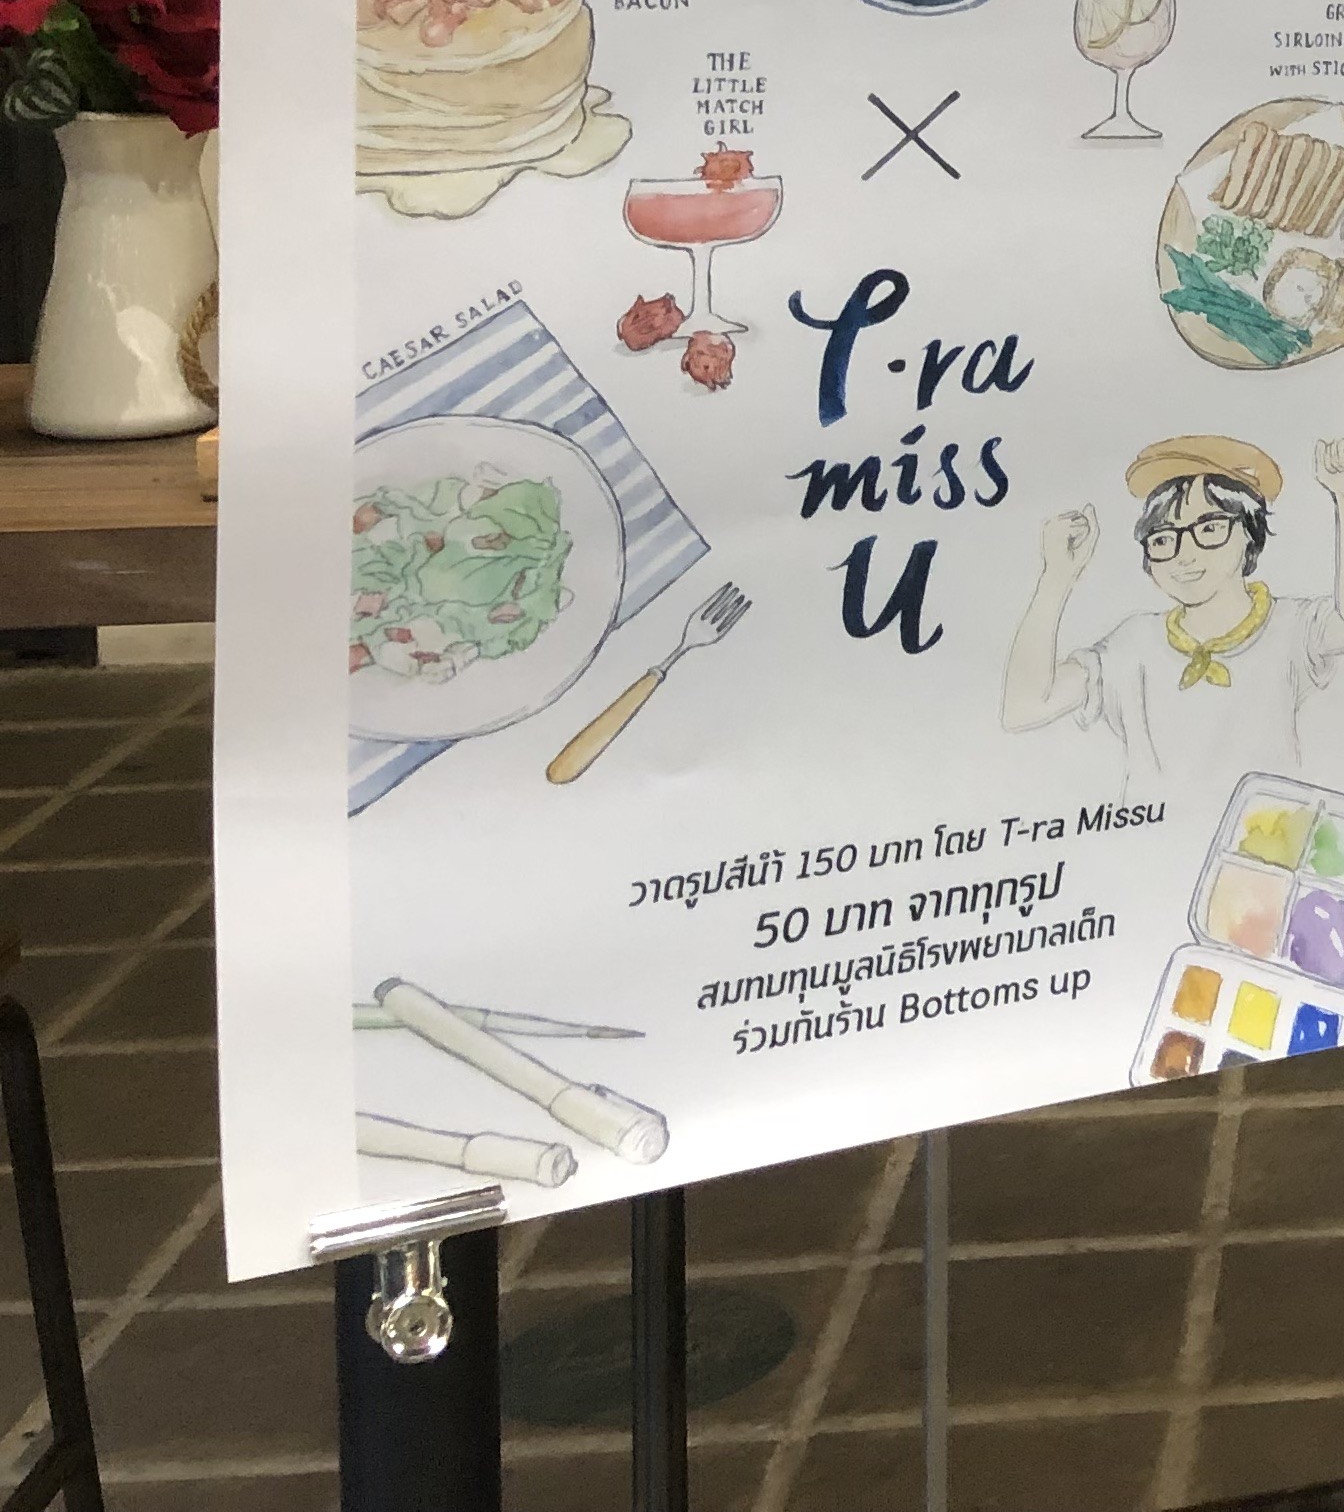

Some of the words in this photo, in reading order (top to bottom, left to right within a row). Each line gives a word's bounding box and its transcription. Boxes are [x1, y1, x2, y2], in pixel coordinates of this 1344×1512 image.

[706, 52, 751, 71] THE
[1274, 31, 1343, 48] SIRLOIN
[692, 76, 767, 95] LITTLE
[1269, 64, 1306, 77] WITH
[696, 98, 764, 116] MATCH
[703, 118, 755, 136] GIRL
[362, 325, 451, 380] CAESAR
[455, 279, 523, 328] SALAD
[784, 423, 1009, 520] miss
[795, 843, 857, 882] 150
[869, 835, 922, 870] บาท
[934, 823, 986, 860] โดย
[1000, 816, 1065, 847] T-ra
[1077, 799, 1166, 835] Missu
[753, 906, 810, 950] 50
[824, 895, 892, 939] บาท
[908, 862, 1065, 925] จากทุกรูป
[695, 907, 1117, 1012] สมทบทุนมูลนิธิโรงพยาบาลเด็ก
[732, 1003, 886, 1057] ร่วมกันร้าน
[899, 974, 1039, 1025] Bottoms
[1049, 967, 1092, 1001] up
